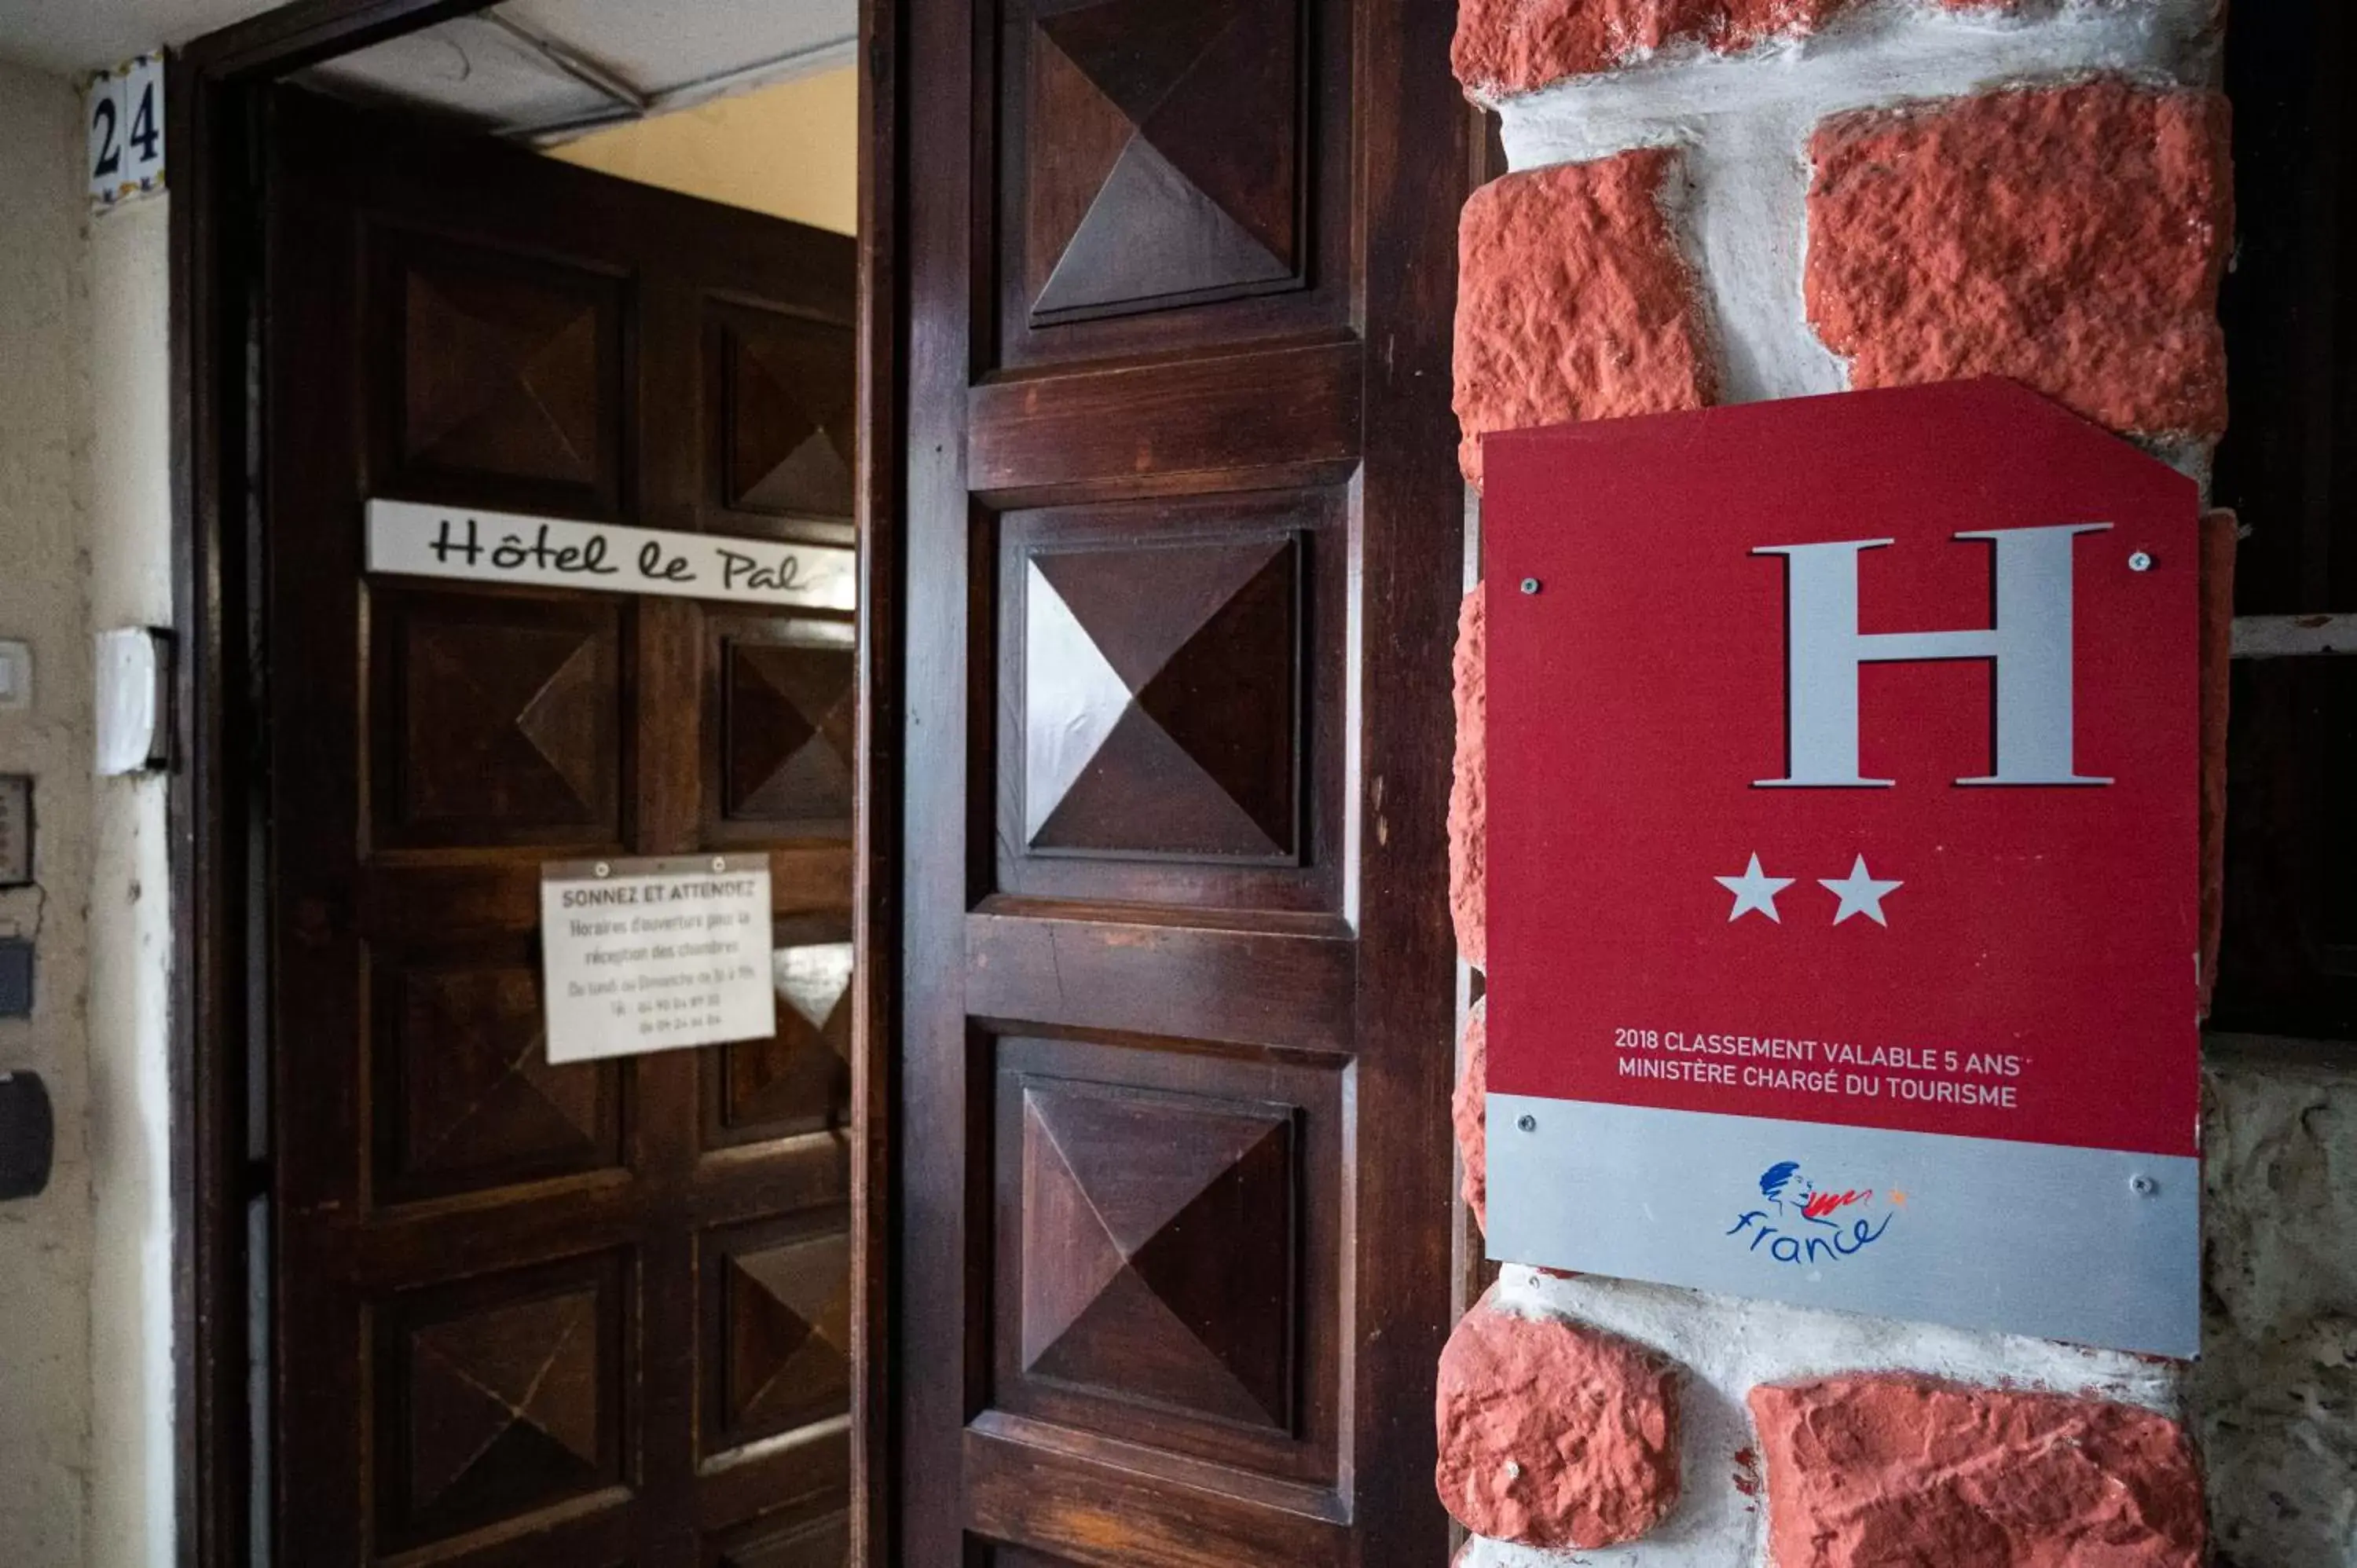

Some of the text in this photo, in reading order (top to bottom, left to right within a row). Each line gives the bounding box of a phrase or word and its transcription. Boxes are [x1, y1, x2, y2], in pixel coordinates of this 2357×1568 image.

[93, 81, 159, 178] 24
[429, 518, 812, 590] Hôtel le Pal
[1752, 522, 2114, 785] H
[562, 879, 756, 909] SONNEZ ET ATTENDEZ
[570, 918, 628, 937] Horaires
[706, 914, 734, 930] pour
[652, 943, 675, 958] des
[1615, 1028, 2021, 1077] 2018 CLASSEMENT VALABLE 5 ANS
[1619, 1057, 2018, 1108] MINISTÈRE CHARGÉ DU TOURISME
